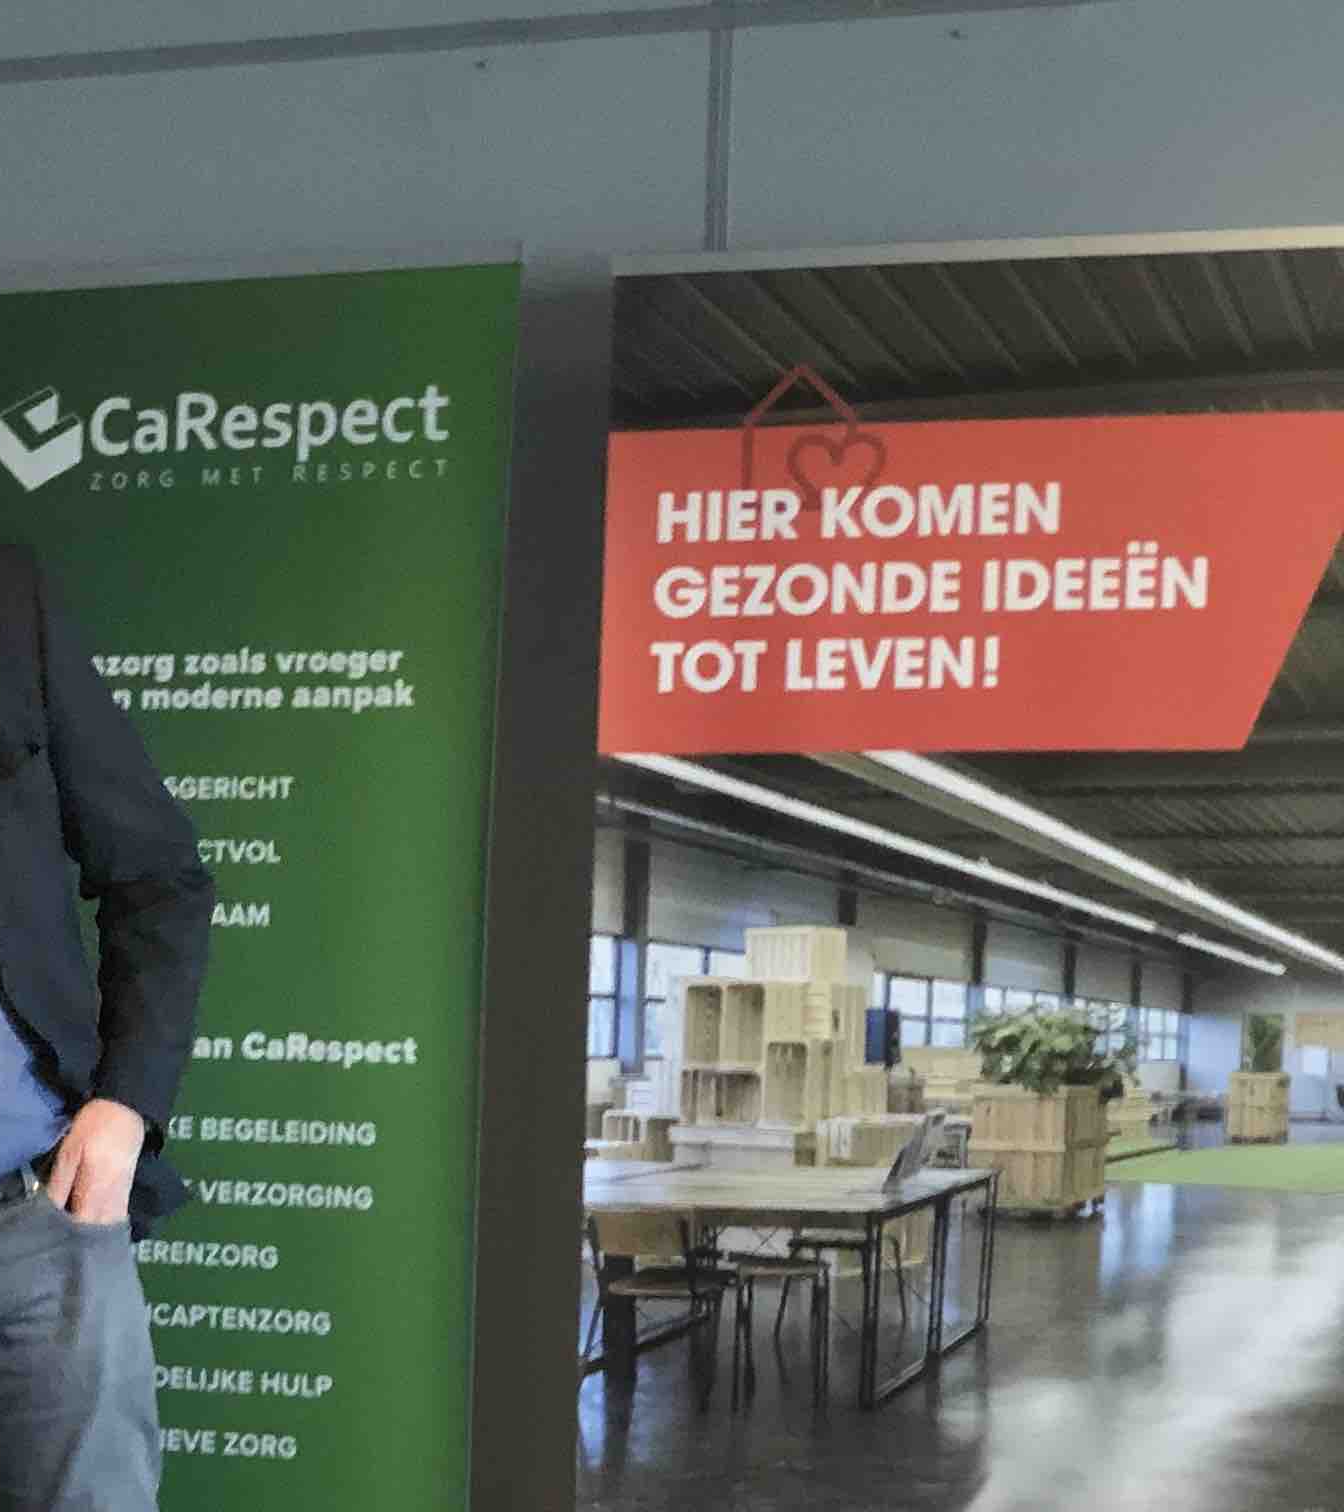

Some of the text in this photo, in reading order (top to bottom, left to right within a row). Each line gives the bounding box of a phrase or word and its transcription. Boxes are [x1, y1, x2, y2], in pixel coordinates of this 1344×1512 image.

[90, 385, 451, 463] CaRespect
[88, 459, 451, 491] ZORG MET RESPECT
[656, 482, 1062, 544] HIER KOMEN
[654, 541, 1209, 619] GEZONDE IDEEËN
[185, 647, 267, 676] zoals
[275, 648, 403, 680] vroeger
[650, 635, 1001, 693] TOT LEVEN!
[142, 681, 284, 710] moderne
[292, 678, 415, 713] aanpak
[241, 1032, 417, 1068] CaRespect
[200, 1116, 377, 1147] BEGELEIDING
[199, 1180, 374, 1211] VERZORGING
[261, 1371, 333, 1398] HULP
[223, 1430, 297, 1460] ZORG
